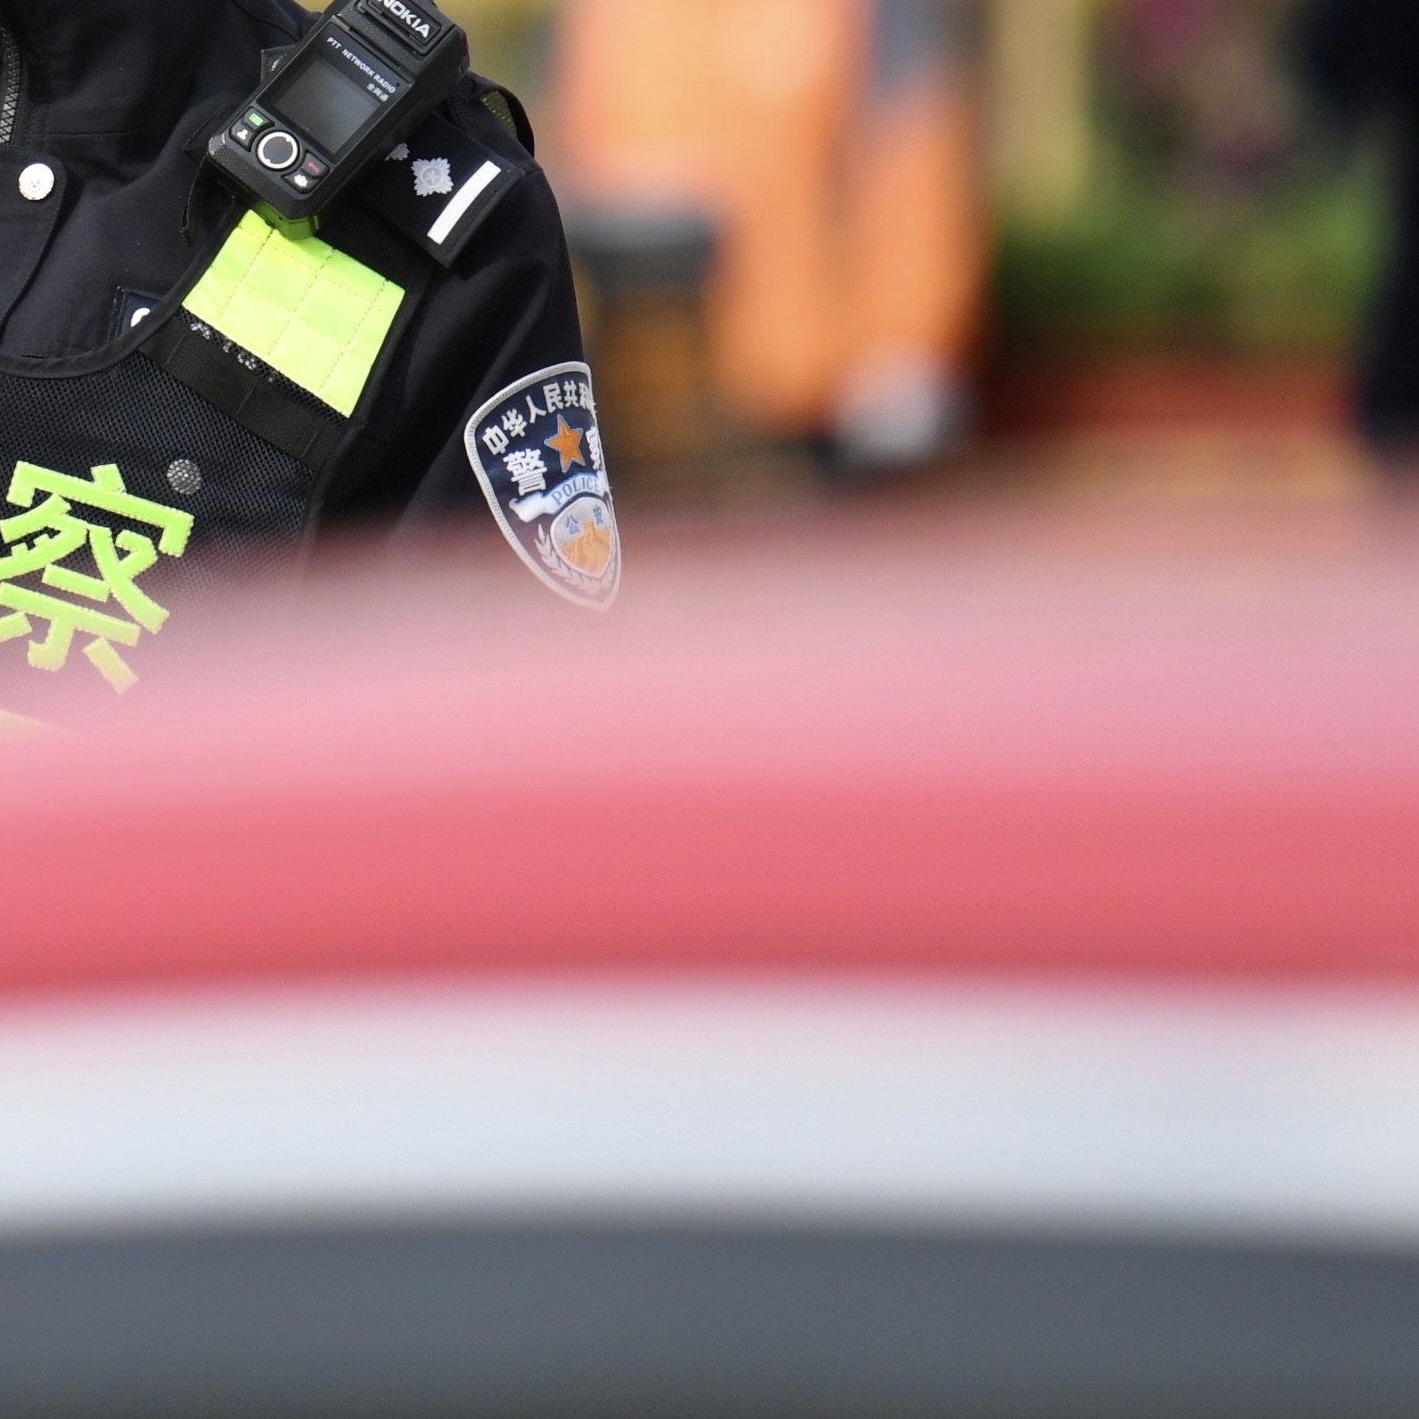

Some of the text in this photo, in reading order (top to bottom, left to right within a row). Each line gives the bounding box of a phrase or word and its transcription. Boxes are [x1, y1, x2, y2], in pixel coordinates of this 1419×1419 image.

[326, 36, 396, 94] PTT NETWORK RADIO
[551, 476, 601, 506] POLICE
